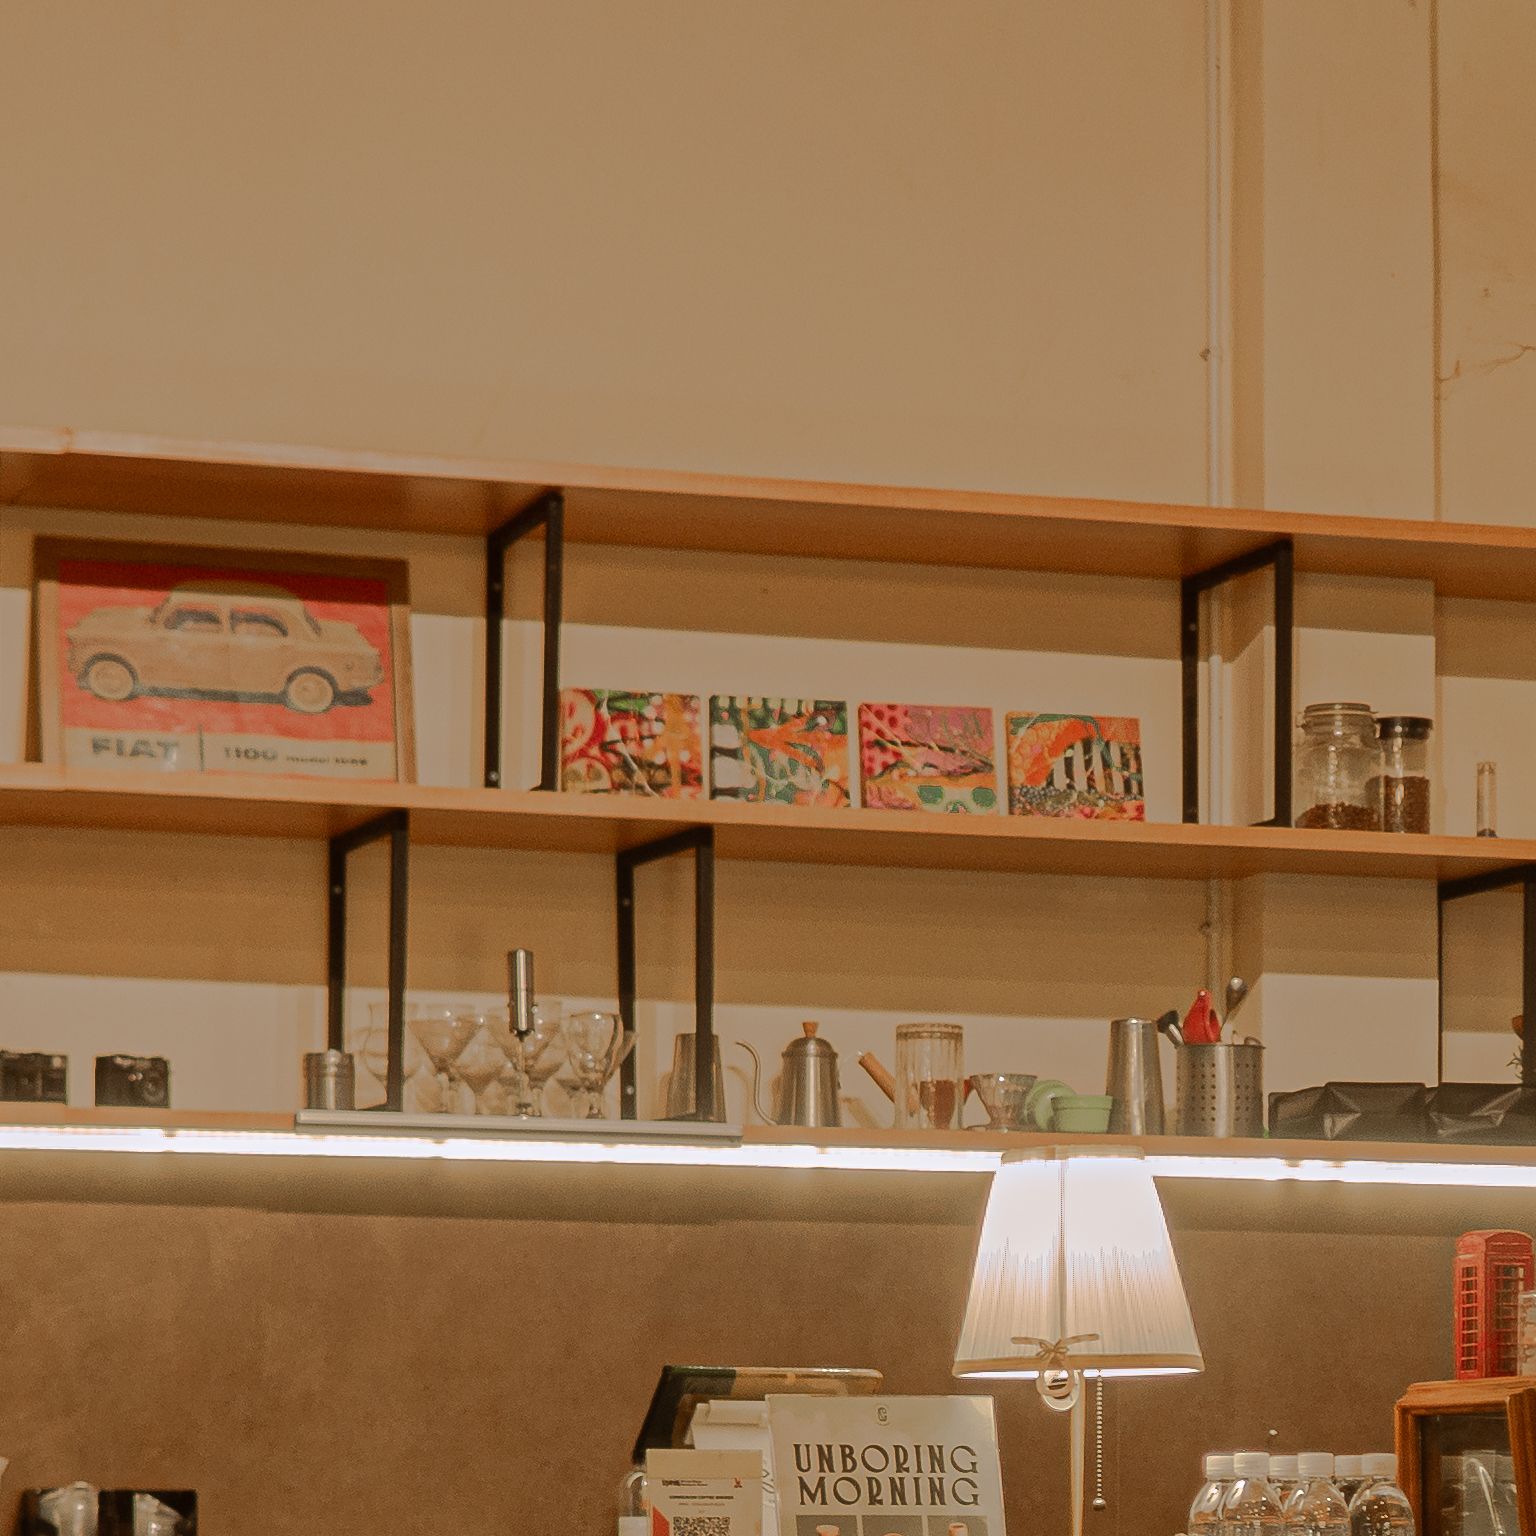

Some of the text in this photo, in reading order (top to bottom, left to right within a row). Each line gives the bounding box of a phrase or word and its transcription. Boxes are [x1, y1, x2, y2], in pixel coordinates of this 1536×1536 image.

[91, 735, 179, 762] FIAT
[793, 1443, 979, 1474] UNBORING
[797, 1476, 980, 1506] MORNING
